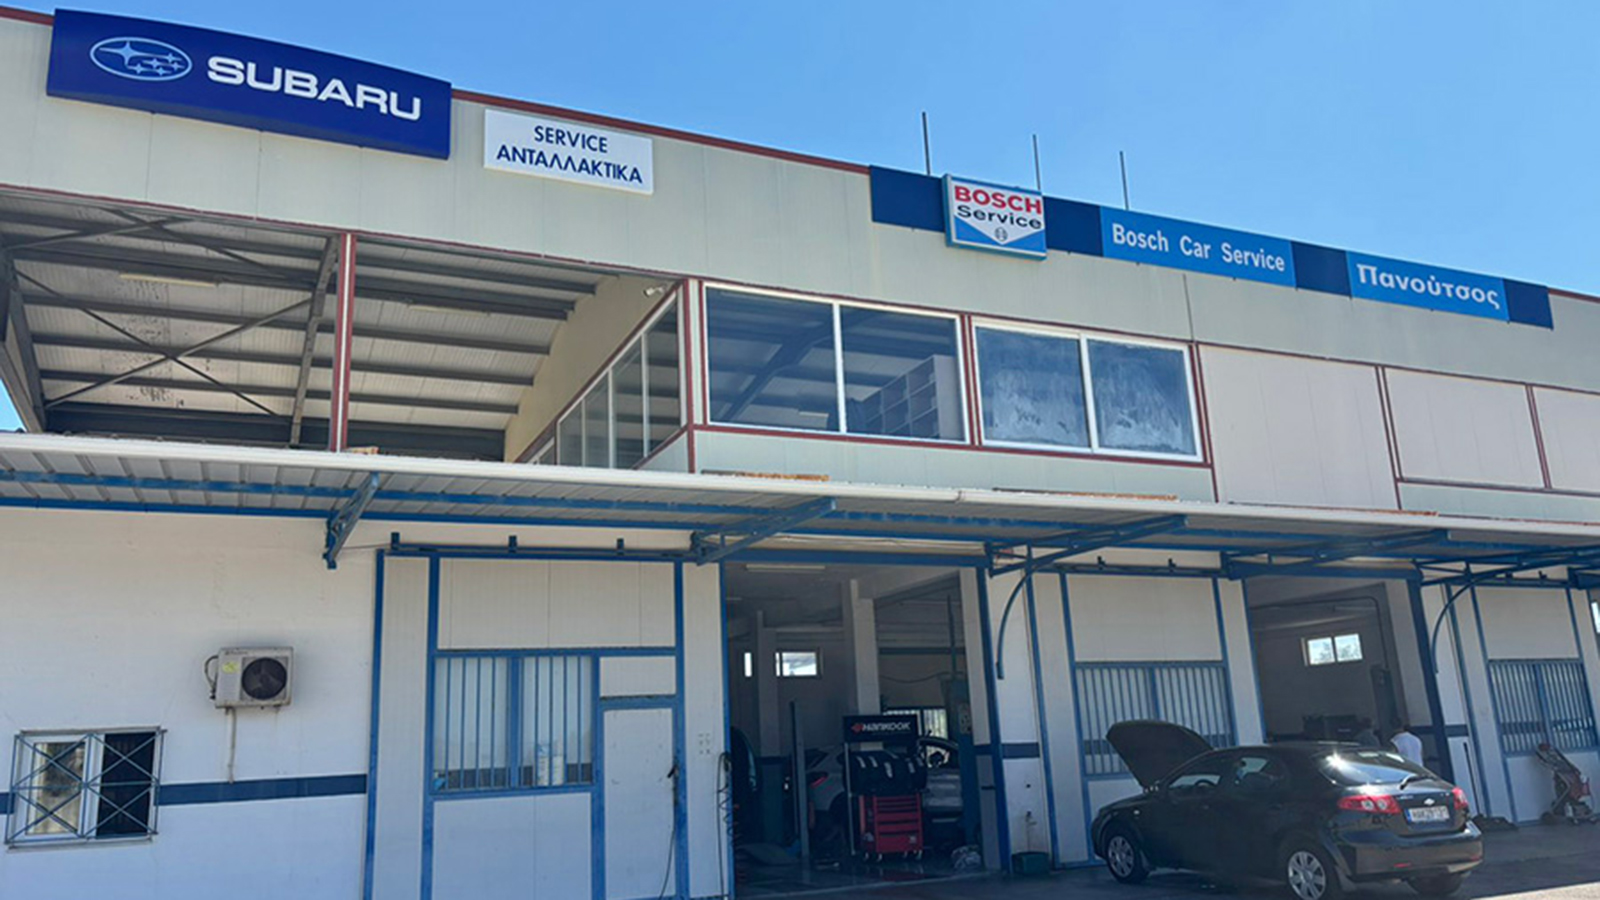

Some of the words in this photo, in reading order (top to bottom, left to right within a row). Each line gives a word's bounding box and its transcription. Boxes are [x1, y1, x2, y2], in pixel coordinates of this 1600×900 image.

[207, 55, 421, 121] SUBARU
[534, 125, 608, 153] SERVICE
[496, 144, 643, 184] ΑΝΤΑΛΛΑΚΤΙΚΑ
[954, 185, 1042, 215] BOSCH
[957, 204, 1042, 230] Service
[1112, 222, 1169, 252] Bosch
[1179, 235, 1211, 259] Car
[1221, 242, 1285, 272] Service
[1356, 263, 1500, 310] Πανούτσος
